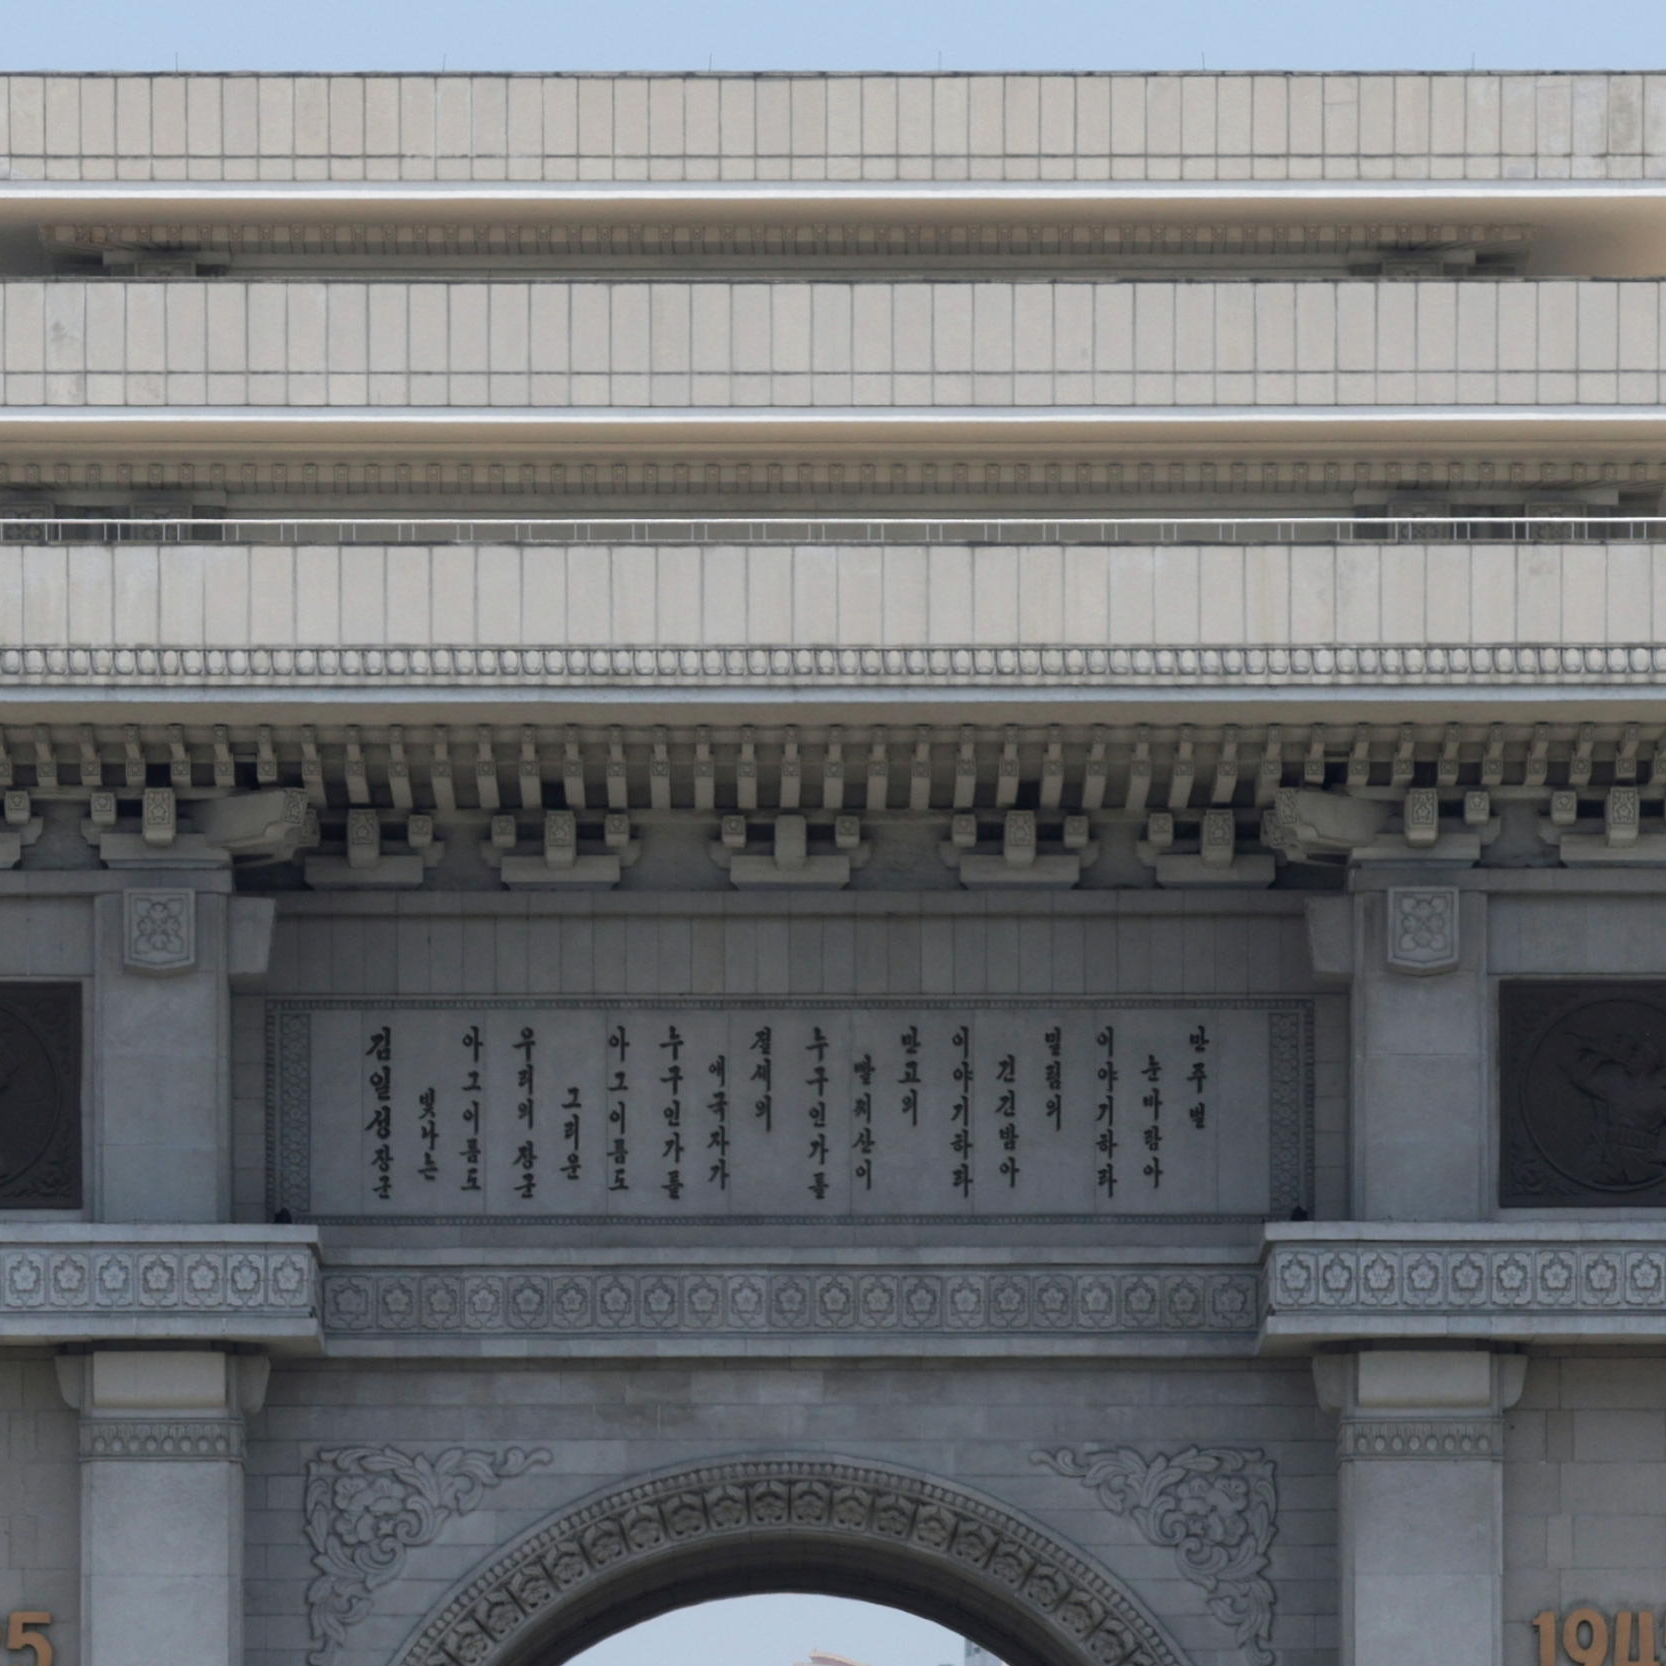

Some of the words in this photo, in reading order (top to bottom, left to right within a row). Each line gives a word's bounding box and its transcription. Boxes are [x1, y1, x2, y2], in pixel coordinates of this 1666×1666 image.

[416, 1086, 440, 1182] 빛나는
[558, 1086, 583, 1181] 그리운
[658, 1025, 685, 1202] 누구인가를
[706, 1054, 731, 1191] 애국자가
[749, 1025, 773, 1133] 절세의
[804, 1025, 830, 1201] 누구인가를
[897, 1025, 922, 1128] 만고의
[949, 1025, 974, 1200] 이야기하라
[994, 1053, 1020, 1190] 긴긴밤아
[1044, 1025, 1063, 1133] 밀림의
[1094, 1025, 1119, 1200] 이야기하라
[1140, 1054, 1165, 1190] 눈바람아
[1186, 1025, 1211, 1131] 만주벌
